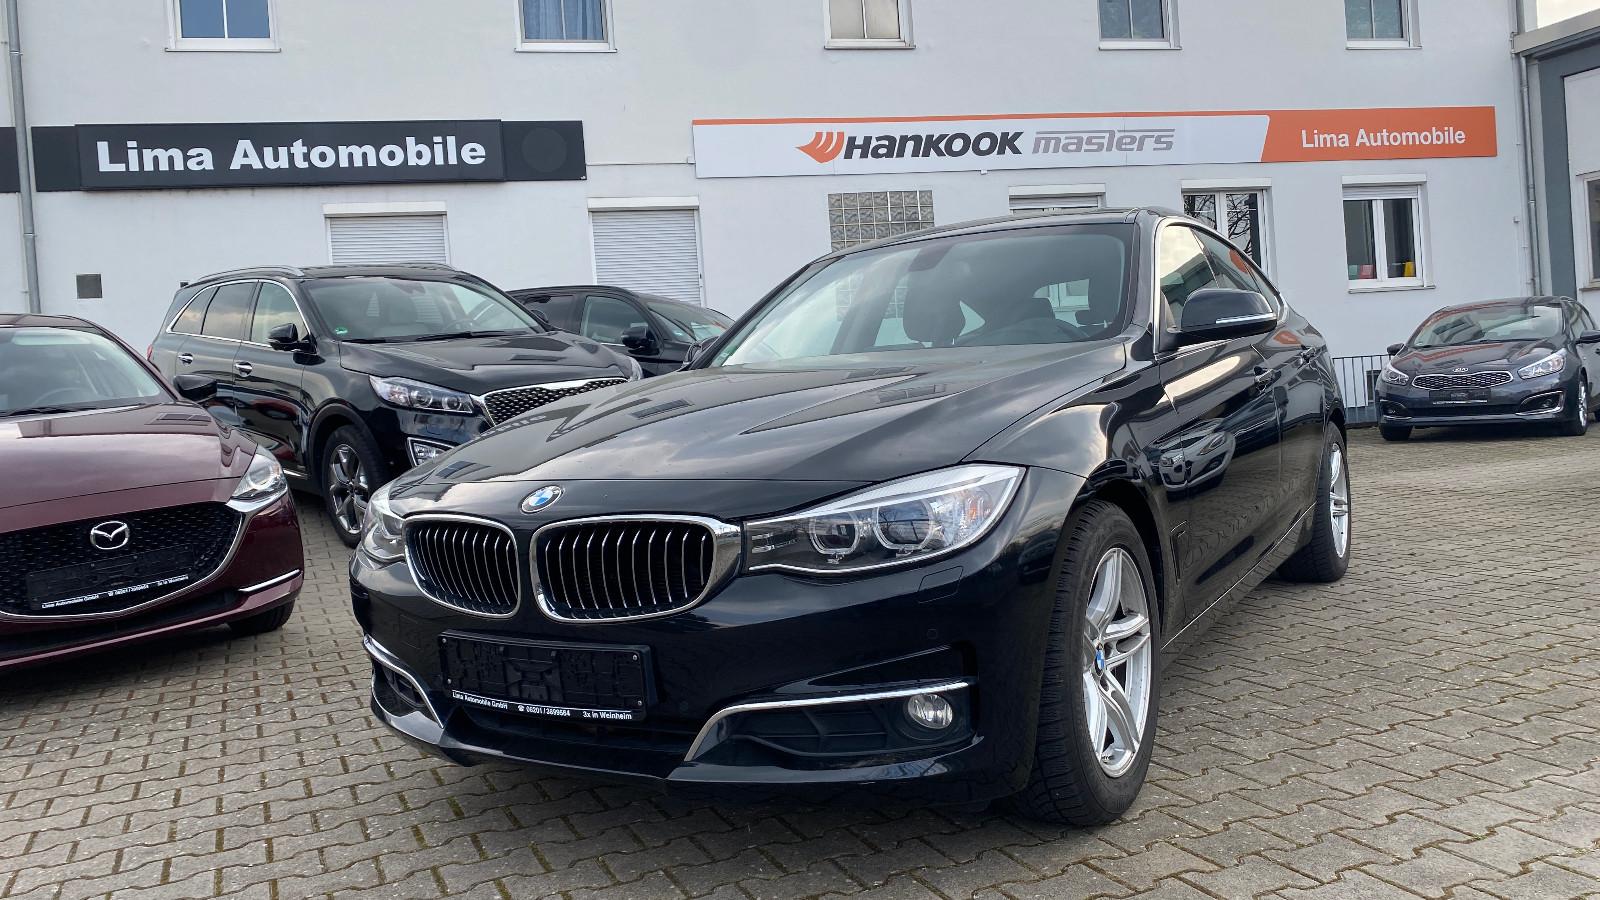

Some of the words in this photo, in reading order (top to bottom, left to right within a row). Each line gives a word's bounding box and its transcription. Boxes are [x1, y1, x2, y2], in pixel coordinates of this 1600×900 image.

[1032, 128, 1176, 155] masters
[1301, 129, 1350, 148] Lima
[1355, 127, 1466, 147] Automobile
[96, 140, 214, 172] Lima
[229, 135, 487, 170] Automobile
[582, 710, 591, 718] 3x
[599, 711, 632, 720] Weinheim
